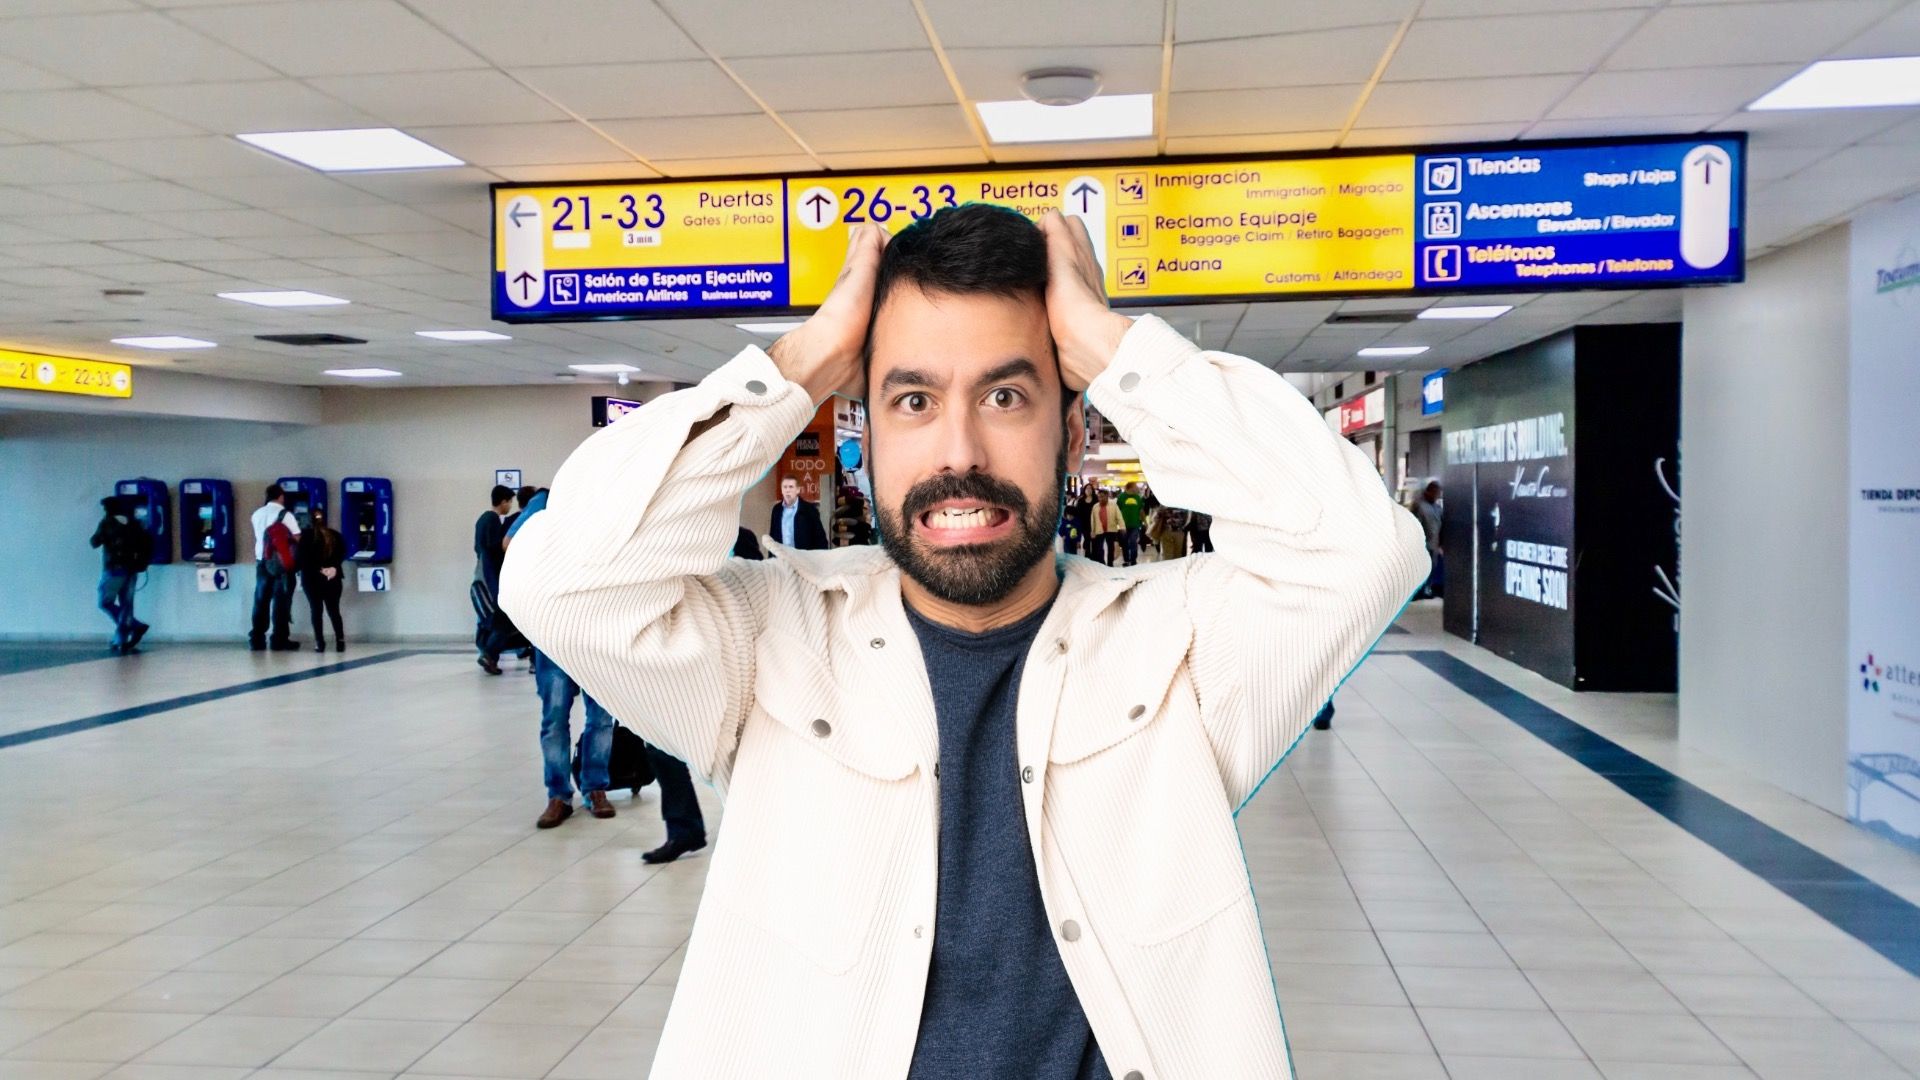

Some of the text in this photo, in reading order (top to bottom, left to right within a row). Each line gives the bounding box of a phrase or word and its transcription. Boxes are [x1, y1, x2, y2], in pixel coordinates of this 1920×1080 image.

[1467, 156, 1541, 176] Tiendas
[1155, 169, 1261, 189] Inmigración
[1584, 172, 1628, 187] Shops
[1637, 169, 1677, 186] Lojas
[699, 190, 774, 208] Puertas
[981, 181, 1059, 199] Puertas
[1246, 185, 1326, 200] Immigration
[1339, 182, 1404, 196] Migração
[552, 194, 666, 231] 21-33
[843, 184, 958, 223] 26-33
[1466, 201, 1573, 221] Ascensores
[683, 215, 721, 227] Gates
[733, 213, 774, 225] Portão
[1155, 210, 1318, 230] Reclamo Equipaje
[1537, 217, 1601, 233] Elevators
[1611, 213, 1676, 230] Elevador
[628, 233, 634, 244] 3
[1181, 233, 1241, 247] Baggage
[1245, 231, 1284, 243] Claim
[1296, 228, 1333, 241] Retiro
[1338, 226, 1404, 240] Bagagem
[1466, 244, 1556, 263] Teléfonos
[1156, 257, 1222, 273] Aduana
[1515, 262, 1597, 279] Telephones
[1606, 257, 1674, 273] Telefones
[584, 269, 773, 288] Salón de Espera Ejecutivo
[1264, 271, 1321, 284] Customs
[584, 289, 774, 304] American Airlines Business Lounge
[1506, 421, 1517, 462] IS
[790, 459, 826, 471] TODO
[804, 471, 812, 481] A
[1861, 489, 1893, 500] TIENDA
[1506, 561, 1568, 610] OPENING SOON
